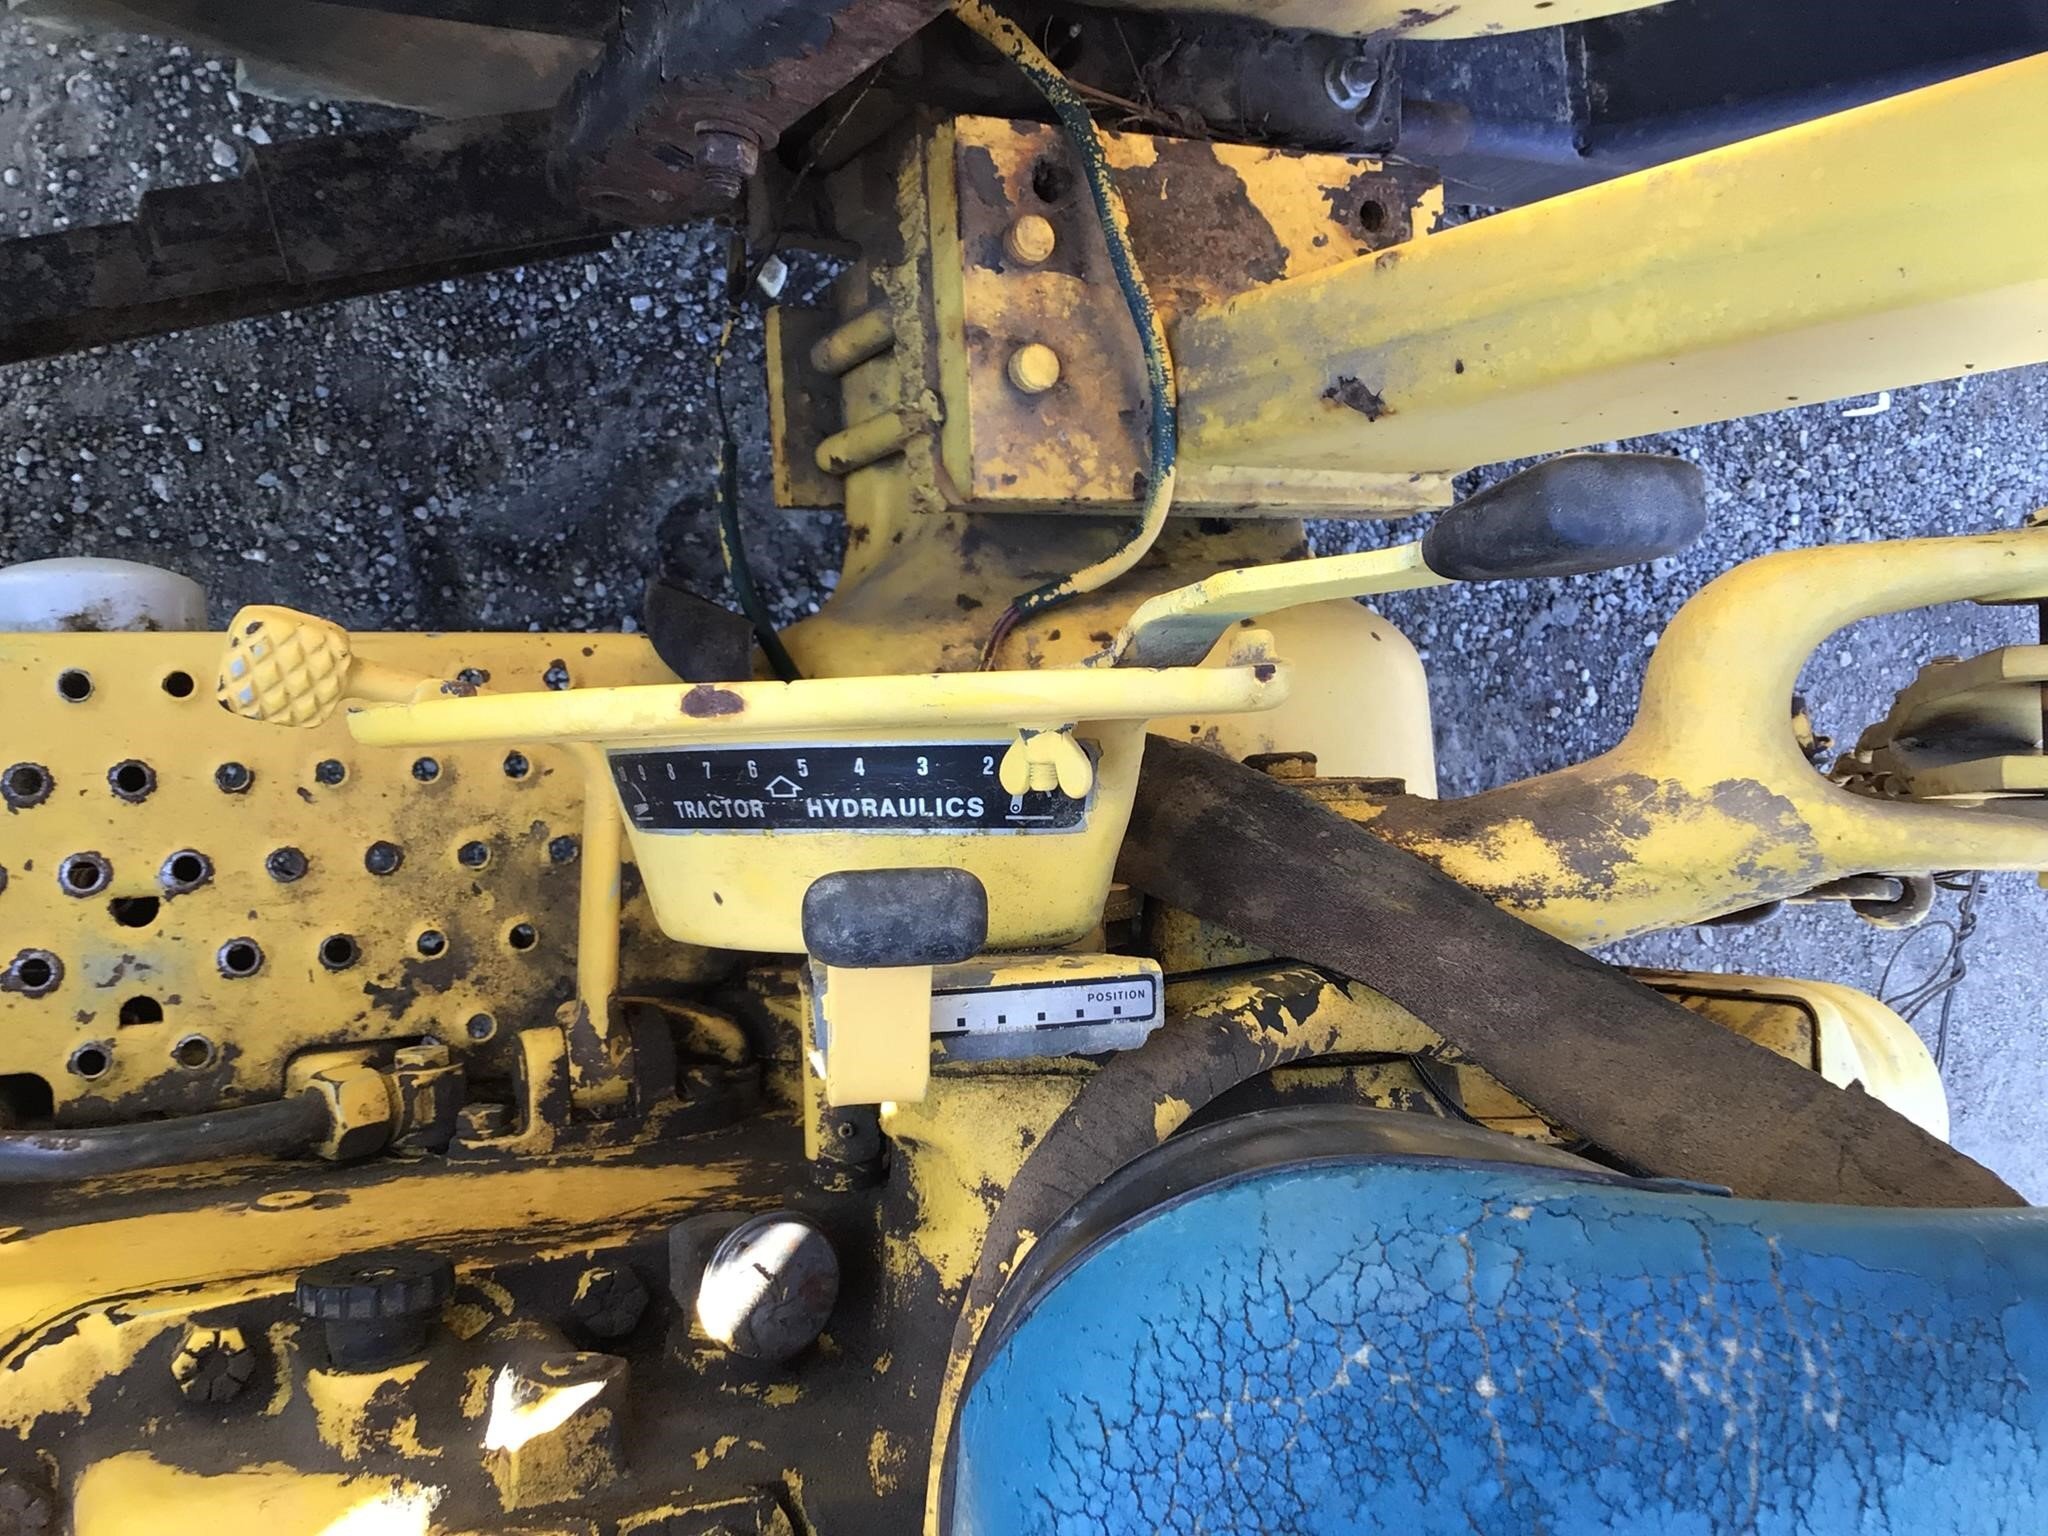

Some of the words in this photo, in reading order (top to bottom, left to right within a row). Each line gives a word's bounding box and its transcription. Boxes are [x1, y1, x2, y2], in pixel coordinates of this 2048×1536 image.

[666, 763, 677, 781] 8
[701, 761, 712, 780] 7
[746, 759, 759, 779] 6
[796, 758, 809, 778] 5
[853, 757, 865, 776] 4
[916, 756, 928, 775] 3
[982, 756, 994, 775] 2
[673, 799, 766, 819] TRACTOR
[806, 797, 984, 818] HYDRAULICS
[1087, 989, 1145, 1002] POSITION
